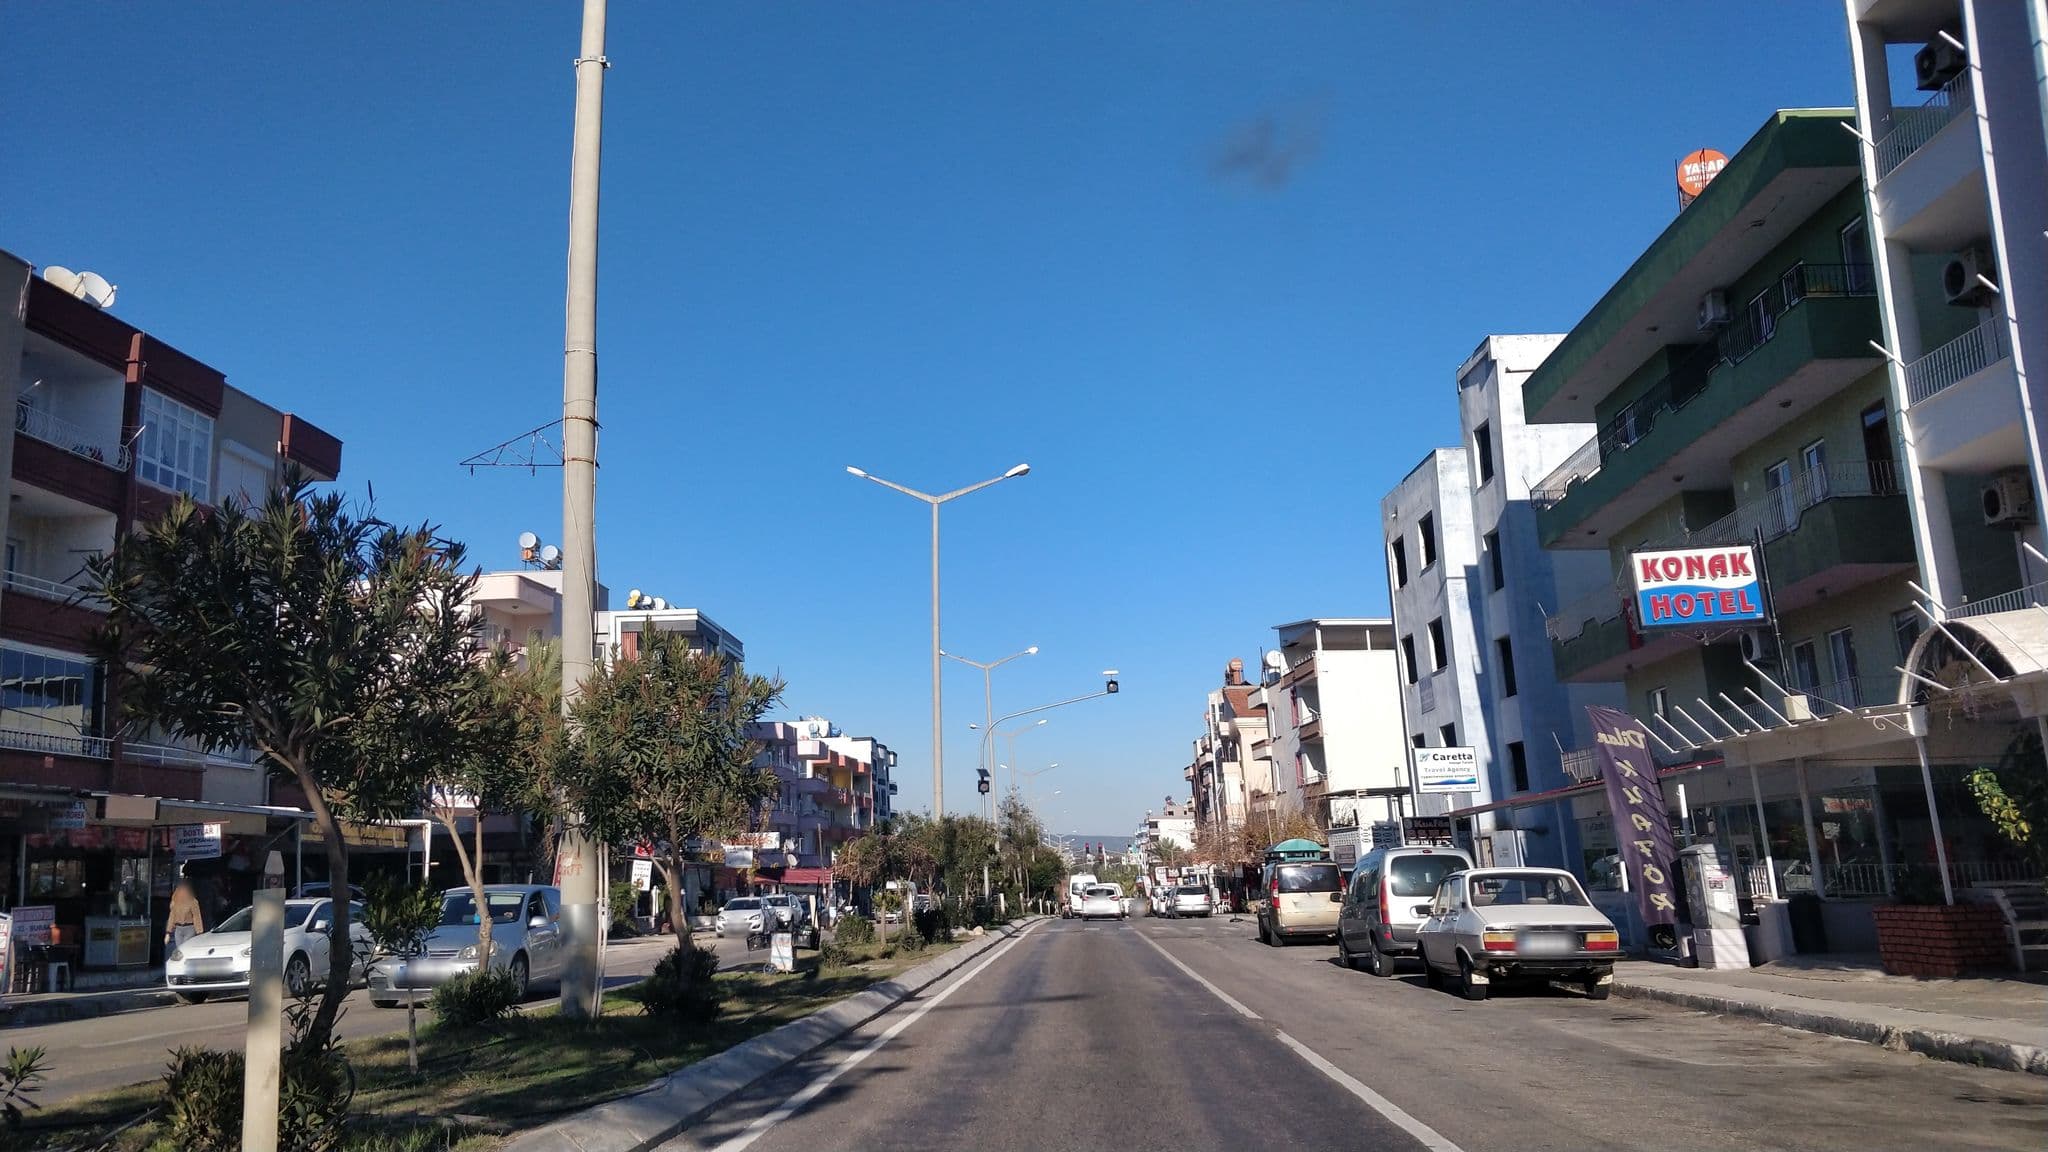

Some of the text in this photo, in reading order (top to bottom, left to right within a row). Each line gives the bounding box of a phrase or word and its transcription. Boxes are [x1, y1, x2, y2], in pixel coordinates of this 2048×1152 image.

[1640, 552, 1752, 582] KONAK
[1651, 588, 1756, 621] HOTEL
[1432, 752, 1473, 761] Caretta
